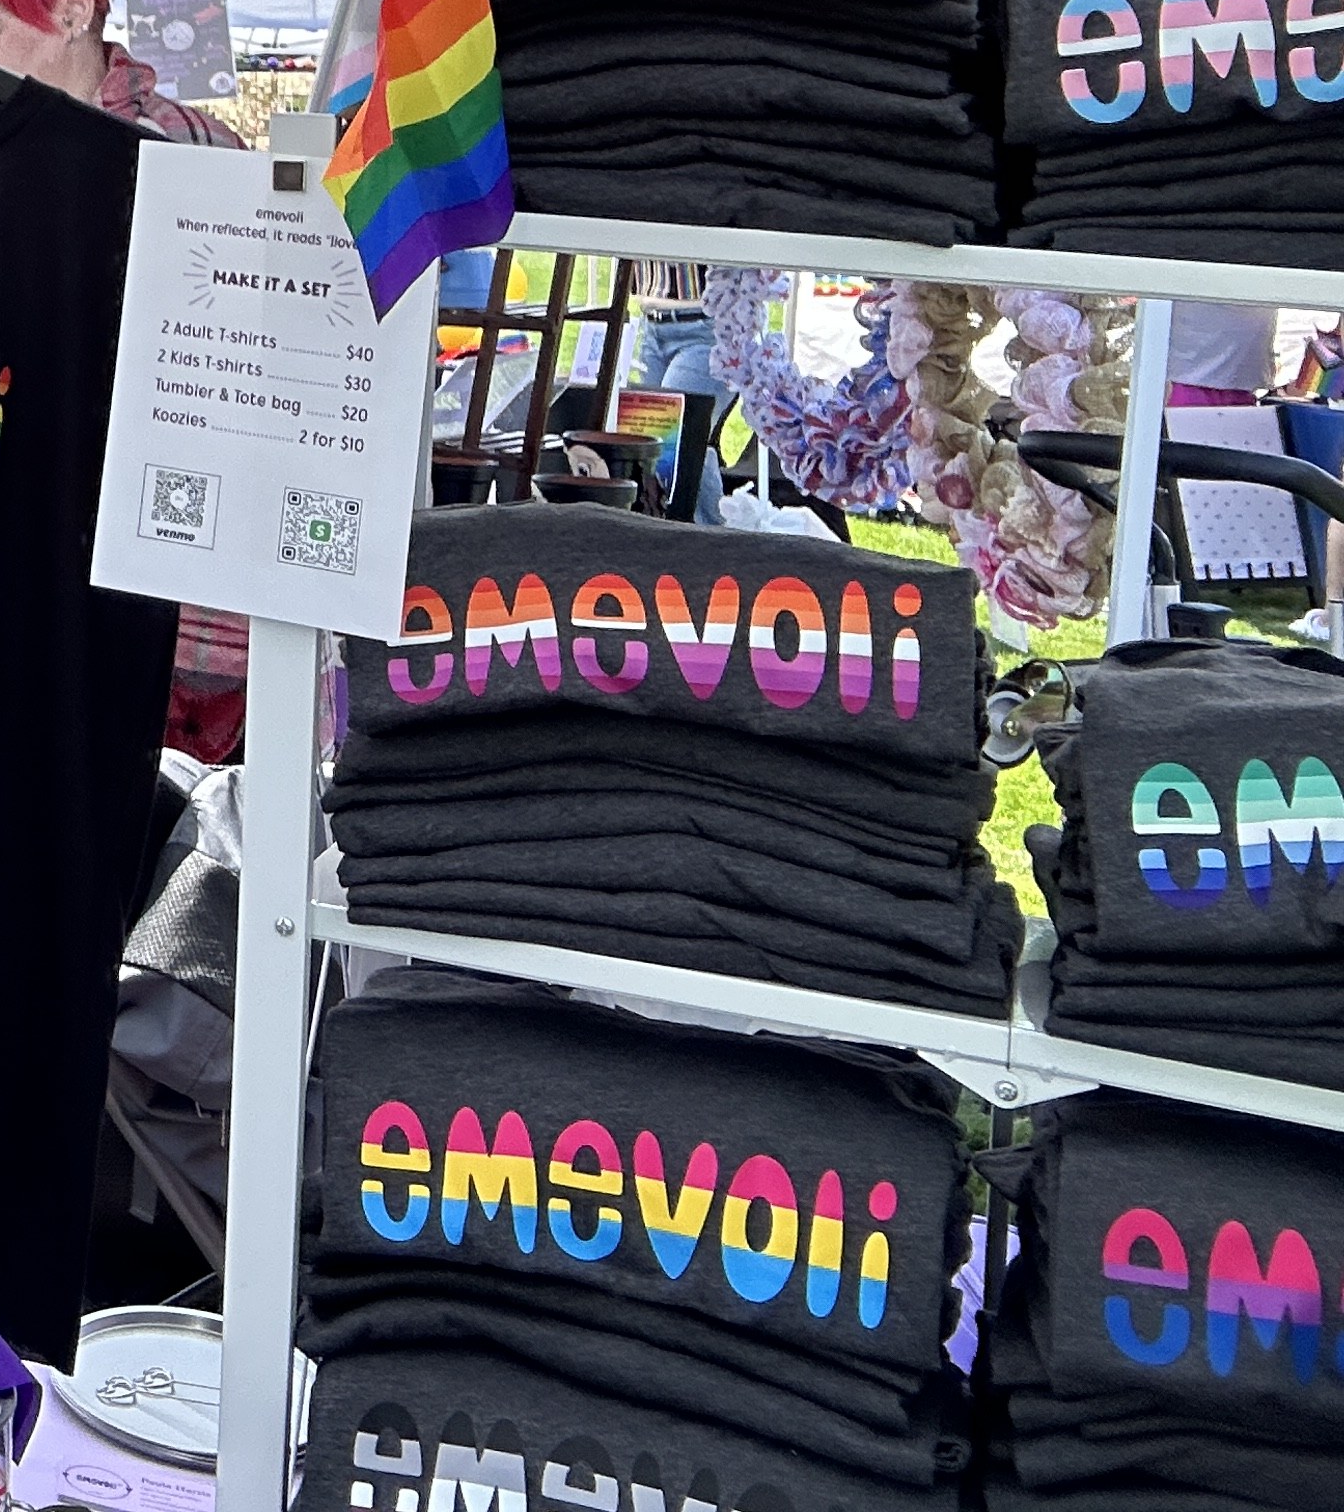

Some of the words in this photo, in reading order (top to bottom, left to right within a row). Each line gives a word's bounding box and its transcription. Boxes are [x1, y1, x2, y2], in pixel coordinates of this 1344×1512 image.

[177, 217, 209, 233] When
[212, 223, 270, 242] reflected,
[273, 229, 283, 241] it
[287, 233, 322, 246] reads
[256, 209, 304, 224] emevoli
[213, 269, 260, 289] MAKE
[283, 279, 297, 293] A
[301, 281, 331, 299] SET
[161, 319, 169, 334] 2
[173, 321, 214, 341] Adult
[220, 327, 279, 349] T-shirts
[345, 344, 373, 362] $40
[157, 349, 166, 363] 2
[170, 349, 200, 368] Kids
[205, 355, 263, 377] T-shirts
[344, 374, 371, 392] $30
[155, 376, 215, 399] Tumbler
[219, 387, 229, 402] &
[234, 389, 266, 407] Tote
[272, 395, 301, 417] bag
[341, 404, 368, 423] $20
[153, 407, 207, 428] Koozies
[299, 429, 307, 444] 2
[313, 431, 336, 448] for
[340, 435, 364, 453] $10
[154, 527, 195, 542] venmo
[387, 573, 922, 721] emevoli
[360, 1099, 898, 1328] emevoli
